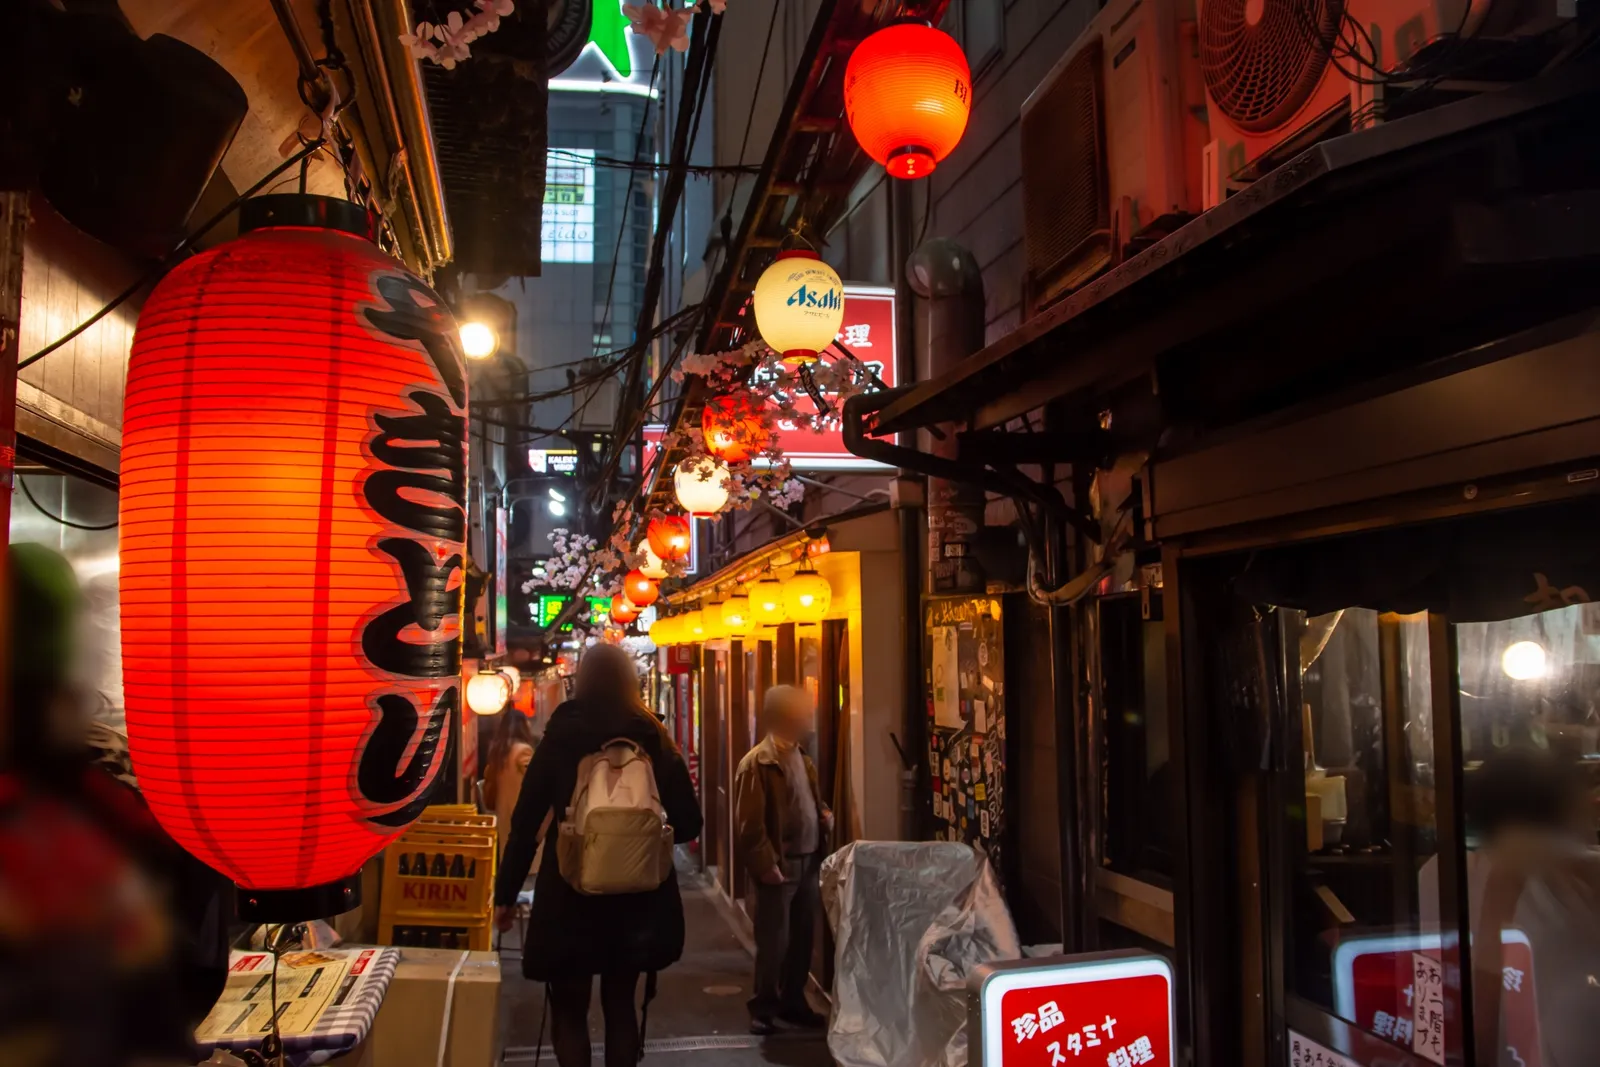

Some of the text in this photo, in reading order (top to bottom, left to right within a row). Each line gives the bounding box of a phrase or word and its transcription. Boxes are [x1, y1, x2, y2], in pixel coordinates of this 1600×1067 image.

[786, 284, 842, 311] Asahi
[403, 882, 468, 902] KIRIN
[1011, 1000, 1065, 1044] 珍品
[1046, 1014, 1117, 1067] スタミナ
[1106, 1035, 1155, 1067] 料理
